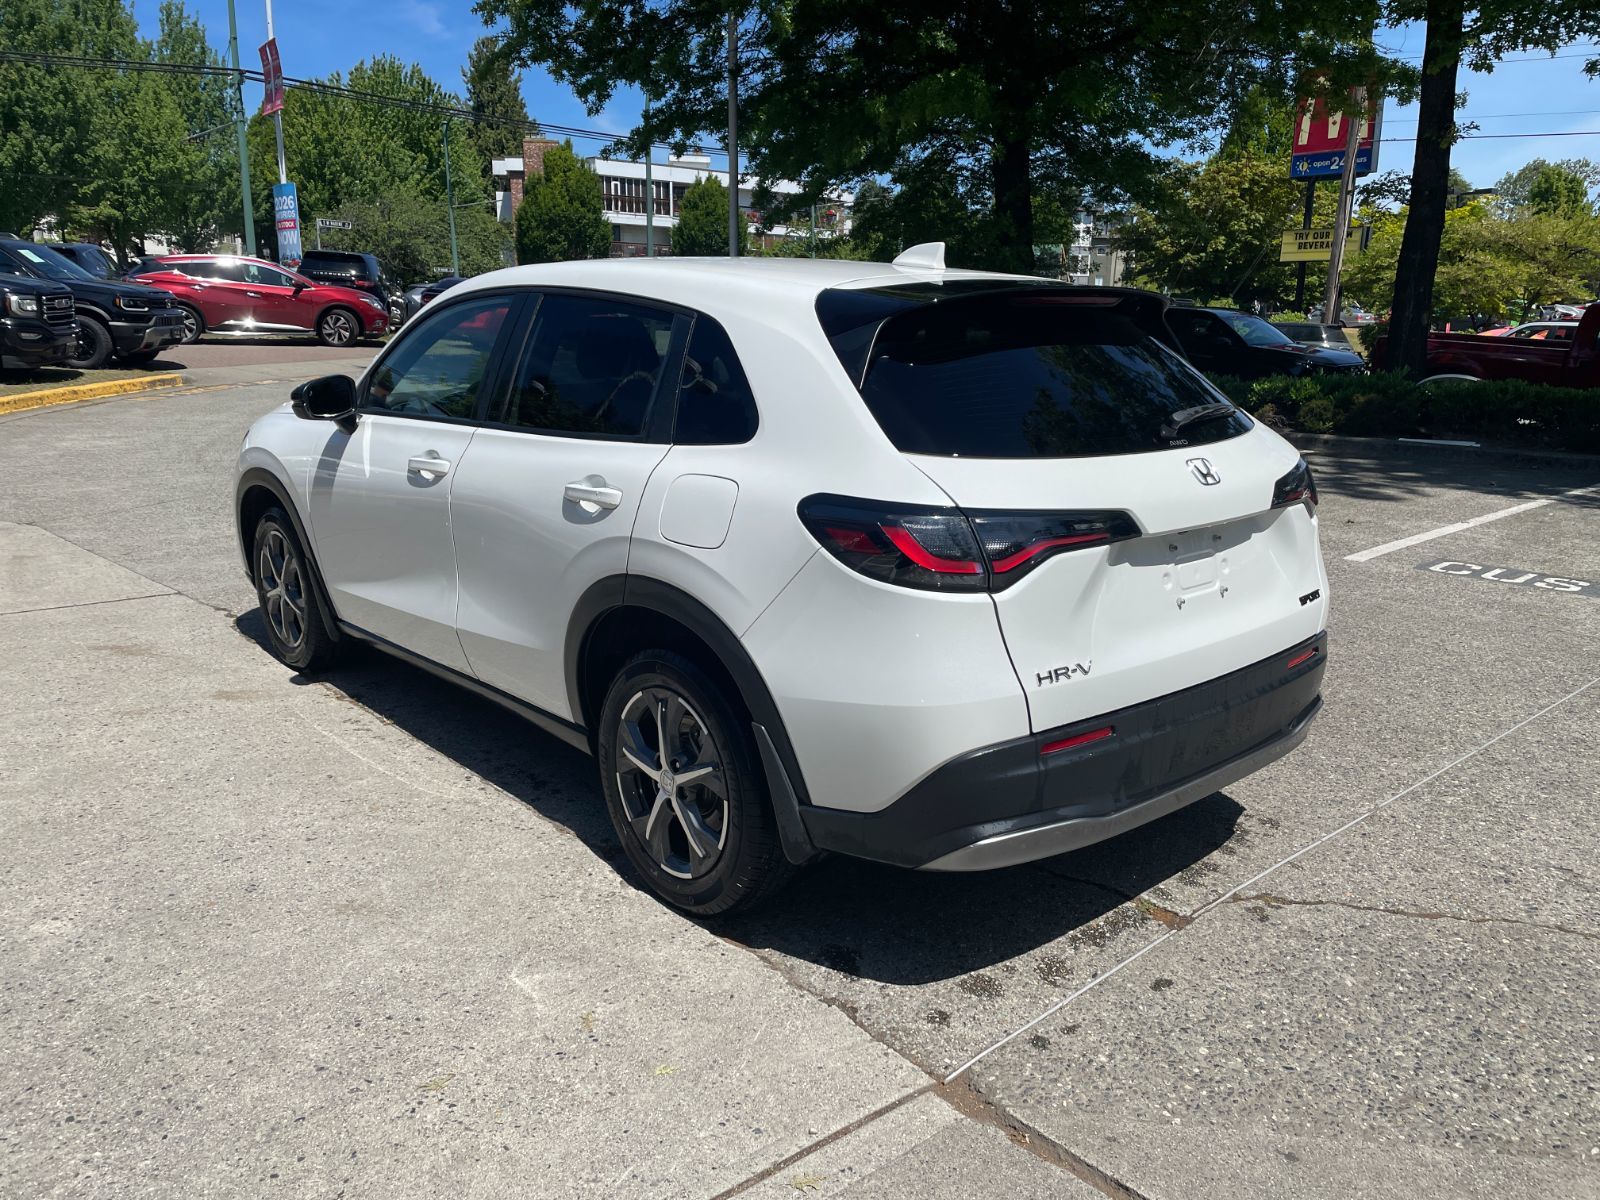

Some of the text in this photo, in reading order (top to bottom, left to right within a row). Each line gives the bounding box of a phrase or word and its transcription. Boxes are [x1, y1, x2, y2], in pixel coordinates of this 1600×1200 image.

[275, 195, 294, 211] 2026
[280, 231, 297, 245] NOW
[1294, 231, 1330, 240] TRY OUR
[1298, 241, 1346, 250] BEVERA
[1429, 561, 1590, 592] CUS
[1299, 588, 1320, 606] SPORT
[1036, 659, 1092, 687] HR-V
